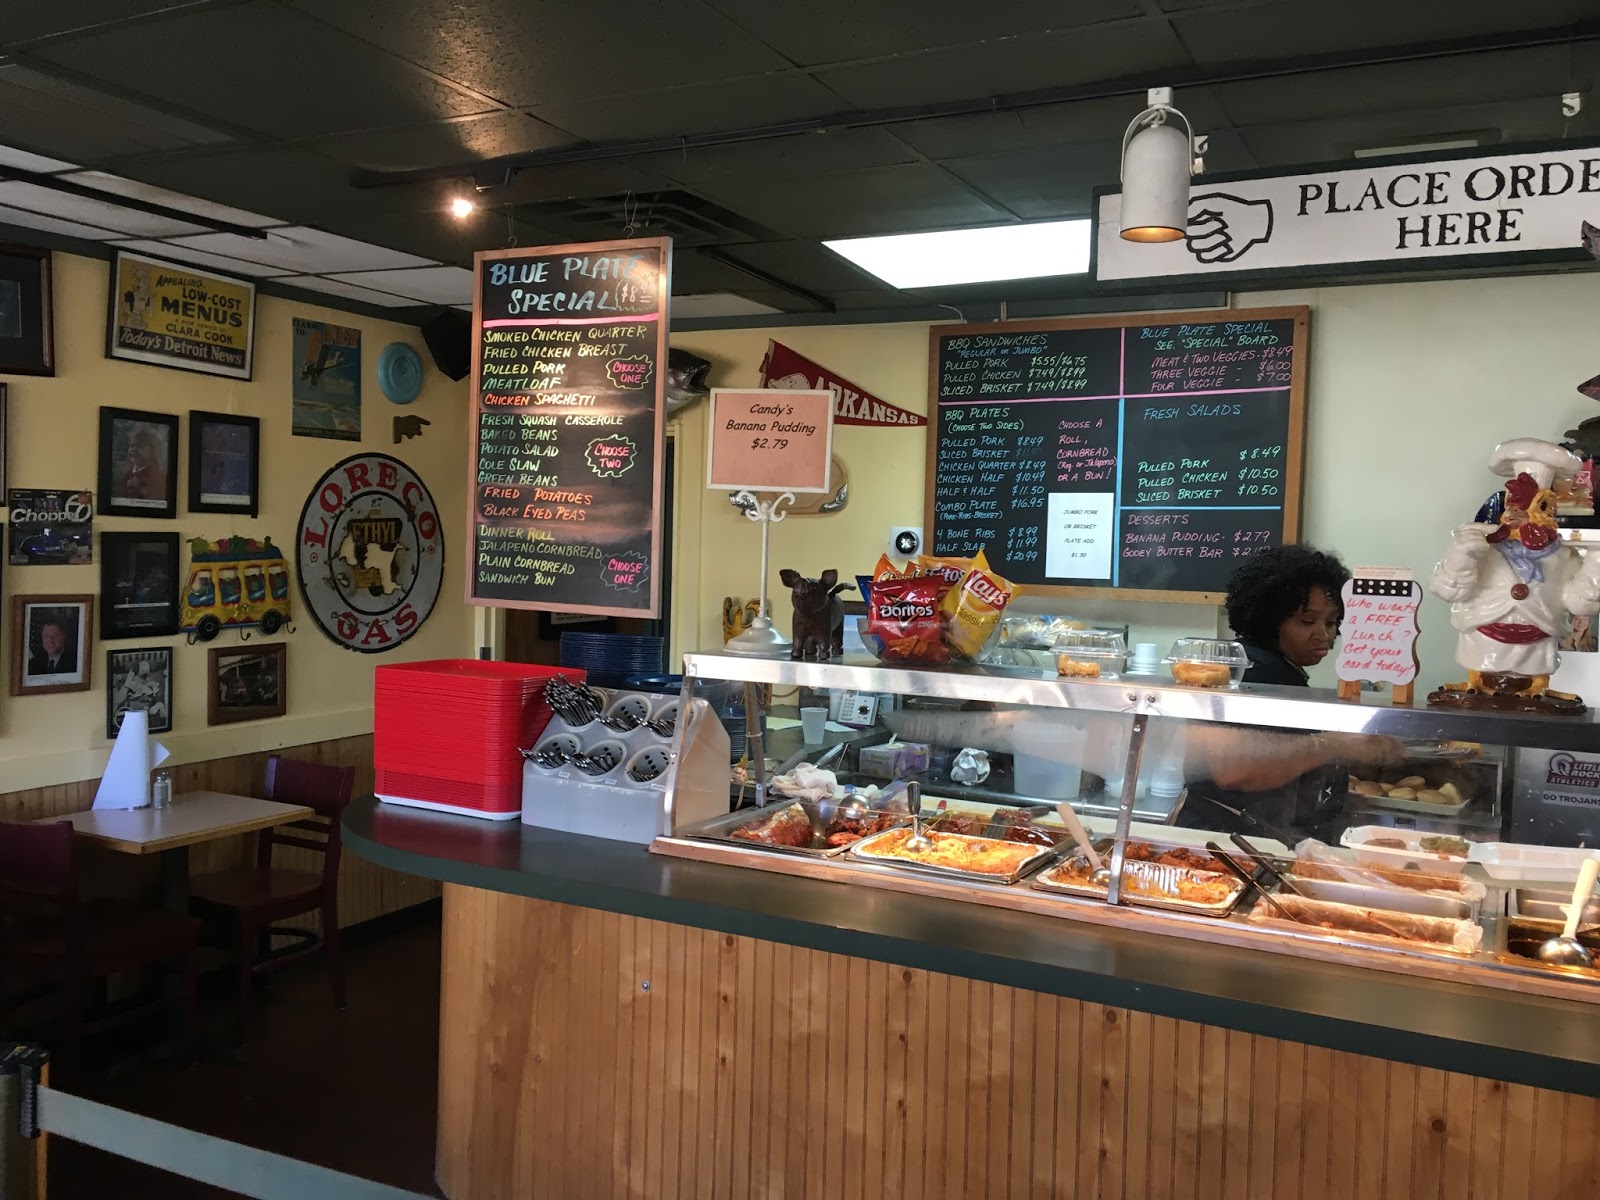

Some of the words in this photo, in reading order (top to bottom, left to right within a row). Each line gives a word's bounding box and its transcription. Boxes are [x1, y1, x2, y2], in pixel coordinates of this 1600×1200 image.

[1297, 172, 1451, 216] PLACE
[1396, 208, 1524, 250] HERE
[489, 263, 550, 285] BLUE
[563, 255, 645, 280] PLATE
[182, 286, 242, 311] LOW-COST
[508, 288, 616, 314] SPECIAL
[160, 296, 243, 328] MENUS
[166, 323, 200, 337] CLARA
[205, 331, 233, 345] COOK
[484, 331, 529, 343] SMOKED
[532, 328, 582, 341] CHICKEN
[588, 326, 647, 339] QUARTER
[1141, 328, 1170, 340] BLUE
[1178, 325, 1216, 337] PLATE
[1223, 322, 1273, 335] SPECIAL
[120, 327, 162, 349] Today's
[164, 336, 208, 358] Detroit
[211, 345, 243, 365] News
[948, 338, 970, 350] BBQ
[973, 334, 1048, 348] SANDWICHES
[1237, 335, 1278, 346] BOARD
[484, 346, 517, 359] FRIED
[522, 345, 572, 358] CHICKEN
[578, 343, 628, 356] BREAST
[945, 360, 979, 370] PULLED
[983, 358, 1009, 368] PORK
[1151, 357, 1179, 368] MEAT
[1192, 353, 1210, 363] TWO
[1212, 350, 1256, 362] VEGGIES
[483, 364, 528, 375] PULLED
[533, 361, 566, 374] PORK
[613, 362, 646, 372] CHOOSE
[1150, 368, 1187, 379] THREE
[1188, 366, 1228, 377] VEGGIE
[620, 373, 641, 383] ONE
[943, 372, 976, 383] PULLED
[982, 369, 1022, 381] CHICKEN
[483, 377, 562, 390] MEATLOAF
[941, 384, 973, 397] SLICED
[980, 383, 1023, 394] BRISKET
[1151, 382, 1175, 392] FOUR
[1183, 378, 1224, 390] VEGGIE
[485, 394, 530, 405] CHICKEN
[534, 393, 595, 406] SPAGHETTI
[749, 404, 794, 416] Candy's
[945, 411, 963, 421] BBQ
[970, 408, 1010, 418] PLATES
[1144, 408, 1180, 421] FRESH
[1187, 404, 1242, 417] SALADS
[482, 414, 514, 425] FRESH
[519, 414, 557, 426] SQUASH
[565, 415, 625, 425] CASSEROLE
[1058, 420, 1091, 429] CHOOSE
[481, 429, 516, 440] BAKED
[521, 429, 558, 440] BEANS
[726, 420, 766, 432] Banana
[770, 422, 816, 436] Pudding
[751, 439, 788, 450] $2.79
[942, 438, 976, 447] PULLED
[981, 436, 1005, 446] PORK
[481, 443, 519, 455] POTATO
[522, 444, 559, 457] SALAD
[594, 443, 629, 456] CHOOSE
[938, 450, 967, 459] SLICED
[972, 450, 1010, 458] BRISKET
[1057, 450, 1108, 459] CORNBREAD
[1239, 446, 1281, 461] $8.49
[479, 458, 505, 470] COLE
[509, 458, 540, 471] SLAW
[599, 459, 621, 468] TWO
[938, 462, 975, 472] CHICKEN
[978, 461, 1016, 471] QUARTER
[1138, 462, 1175, 473] PULLED
[1180, 459, 1210, 470] PORK
[478, 472, 514, 484] GREEN
[519, 474, 558, 486] BEANS
[937, 474, 973, 484] CHICKEN
[981, 472, 1004, 482] HALF
[1058, 474, 1071, 482] OR
[1138, 477, 1174, 489] PULLED
[1182, 471, 1228, 484] CHICKEN
[1238, 468, 1279, 480] $10.50
[484, 487, 520, 499] FRIED
[534, 488, 593, 505] POTATOES
[937, 488, 960, 496] HALF
[971, 487, 996, 496] HALF
[1012, 486, 1045, 495] $11.50
[1136, 491, 1170, 502] SLICED
[1178, 489, 1223, 500] BRISKET
[1238, 484, 1278, 496] $10.50
[304, 462, 436, 548] LORECO
[969, 500, 998, 510] PLATE
[1011, 498, 1045, 509] $16.95
[483, 504, 519, 516] BLACK
[523, 505, 552, 519] EYED
[555, 506, 586, 520] PEAS
[1128, 514, 1190, 525] DESSERTS
[480, 525, 523, 538] DINNER
[527, 527, 555, 541] ROLL
[937, 529, 943, 538] 4
[947, 530, 970, 539] BONE
[975, 528, 996, 539] RIBS
[1125, 533, 1166, 543] BANANA
[1233, 530, 1271, 543] $2.79
[479, 541, 534, 552] JALAPENO
[537, 543, 602, 559] CORNBREAD
[936, 543, 958, 552] HALF
[962, 542, 985, 551] SLAB
[1122, 549, 1152, 558] GOOEY
[1157, 546, 1193, 557] BUTTER
[1199, 546, 1223, 558] BAR
[479, 554, 511, 567] PLAIN
[514, 556, 575, 575] CORNBREAD
[608, 559, 643, 572] CHOOSE
[479, 571, 529, 584] SANDWICH
[534, 573, 555, 586] BUN
[614, 574, 634, 584] ONE
[880, 605, 933, 617] Doritos
[1347, 598, 1372, 608] Who
[1378, 602, 1418, 613] wants
[954, 605, 983, 628] Classic
[1348, 616, 1357, 624] a
[1364, 614, 1407, 626] FREE
[336, 603, 418, 645] GAS
[1344, 643, 1367, 654] Get
[1371, 647, 1402, 658] your
[1343, 660, 1372, 669] card
[1550, 778, 1595, 786] ATHLETICS
